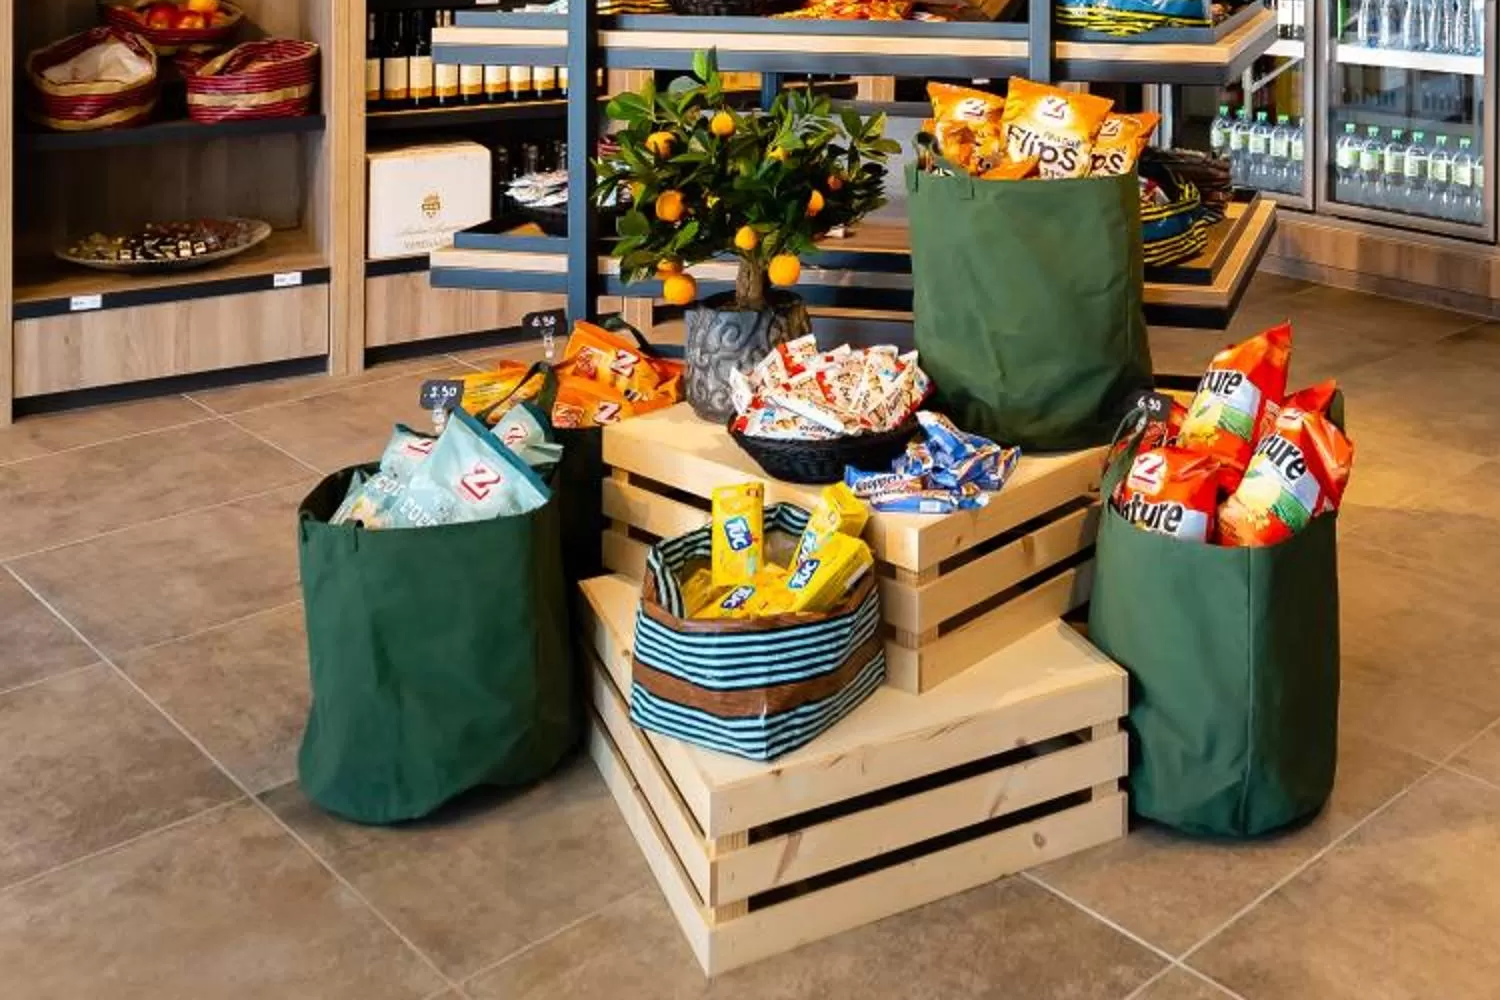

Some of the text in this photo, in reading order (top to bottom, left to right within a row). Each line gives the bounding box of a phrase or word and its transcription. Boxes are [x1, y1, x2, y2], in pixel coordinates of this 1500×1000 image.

[1007, 124, 1079, 172] Flips
[726, 518, 750, 550] TUC
[789, 559, 818, 588] TUC
